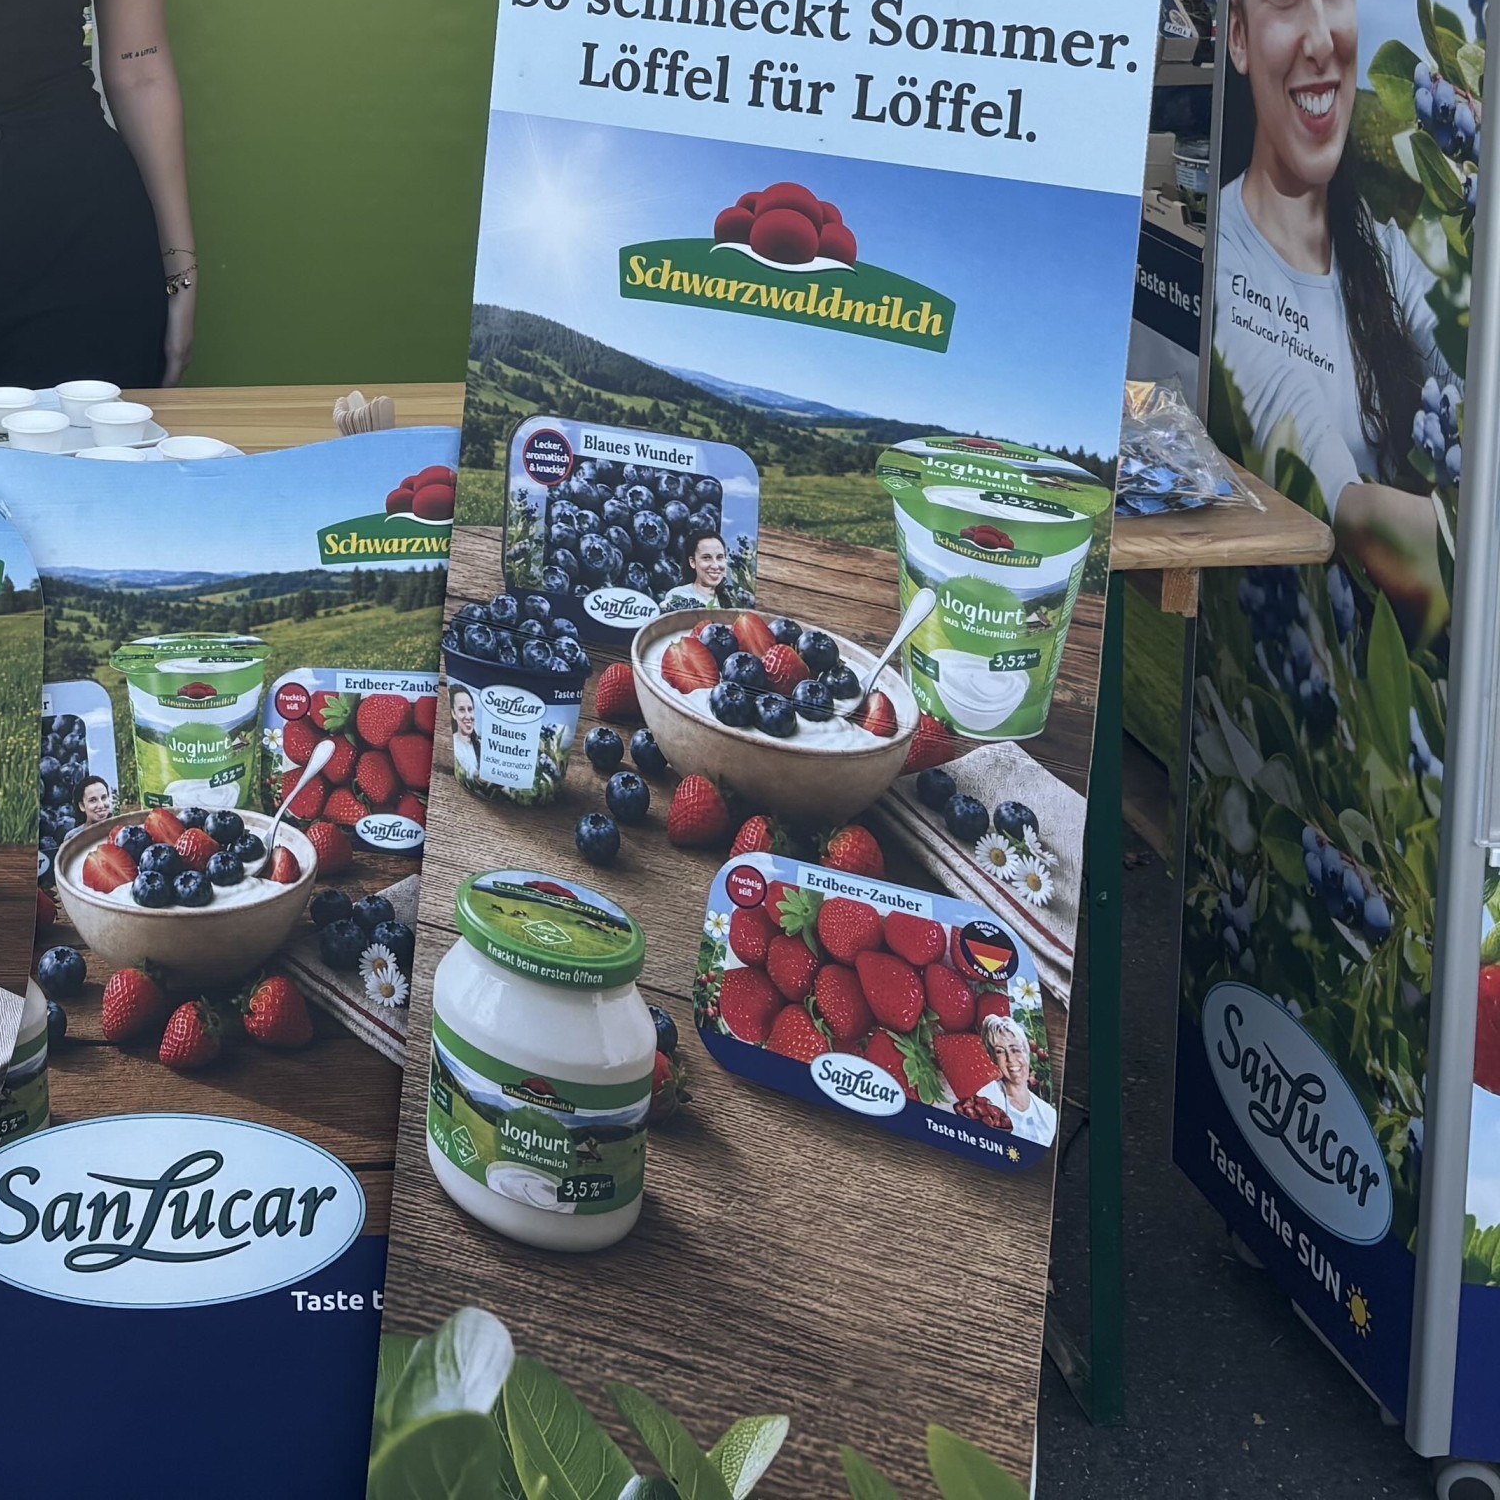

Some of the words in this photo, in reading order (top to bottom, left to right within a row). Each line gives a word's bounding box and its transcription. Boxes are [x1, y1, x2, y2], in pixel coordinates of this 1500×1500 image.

[580, 41, 730, 104] Löffel
[749, 60, 835, 115] für
[852, 72, 1038, 142] Löffel.
[626, 255, 944, 338] Schwarzwaldmilch
[1169, 282, 1190, 312] the
[1232, 274, 1271, 312] Elena
[1276, 295, 1309, 334] Vega
[1231, 306, 1280, 344] SanLucar
[1281, 330, 1334, 374] Pflückerin
[525, 451, 569, 463] aromatisch
[534, 439, 563, 451] Lecker,
[584, 435, 630, 456] Blaues
[634, 442, 693, 466] Wunder
[536, 464, 566, 475] knackig!
[921, 456, 1034, 485] Joghurt
[949, 473, 1028, 494] Weidemilch
[935, 533, 1040, 566] Schwarzwaldmilch
[590, 594, 656, 620] SanLucar
[941, 591, 1024, 626] Joghurt
[944, 617, 959, 628] aus
[961, 623, 1017, 640] Weidemilch
[994, 655, 1026, 672] 3,5%
[280, 693, 306, 703] fruchtig
[485, 691, 542, 716] SanLucar
[554, 690, 575, 699] Taste
[492, 723, 526, 740] Blaues
[169, 737, 231, 757] Joghurt
[488, 738, 531, 757] Wunder
[213, 771, 235, 785] 3,5%
[361, 819, 422, 841] SanLucar
[731, 875, 762, 890] fruchtig
[807, 873, 922, 912] Erdbeer-Zauber
[974, 922, 999, 935] Sonne
[487, 941, 515, 965] Knackt
[516, 955, 538, 974] beim
[541, 966, 571, 983] ersten
[573, 969, 603, 984] Öffnen
[973, 965, 989, 978] von
[992, 970, 1009, 981] hier
[819, 1059, 900, 1104] SanLucar
[1217, 1004, 1380, 1207] SanLucar
[501, 1119, 570, 1154] Joghurt
[926, 1118, 956, 1139] Taste
[957, 1129, 977, 1146] the
[978, 1137, 1004, 1155] SUN
[501, 1143, 516, 1155] aus
[517, 1148, 568, 1170] Weidemilch
[1207, 1130, 1256, 1206] Taste
[1261, 1191, 1293, 1248] the
[1298, 1232, 1341, 1302] SUN
[291, 1290, 364, 1312] Taste
